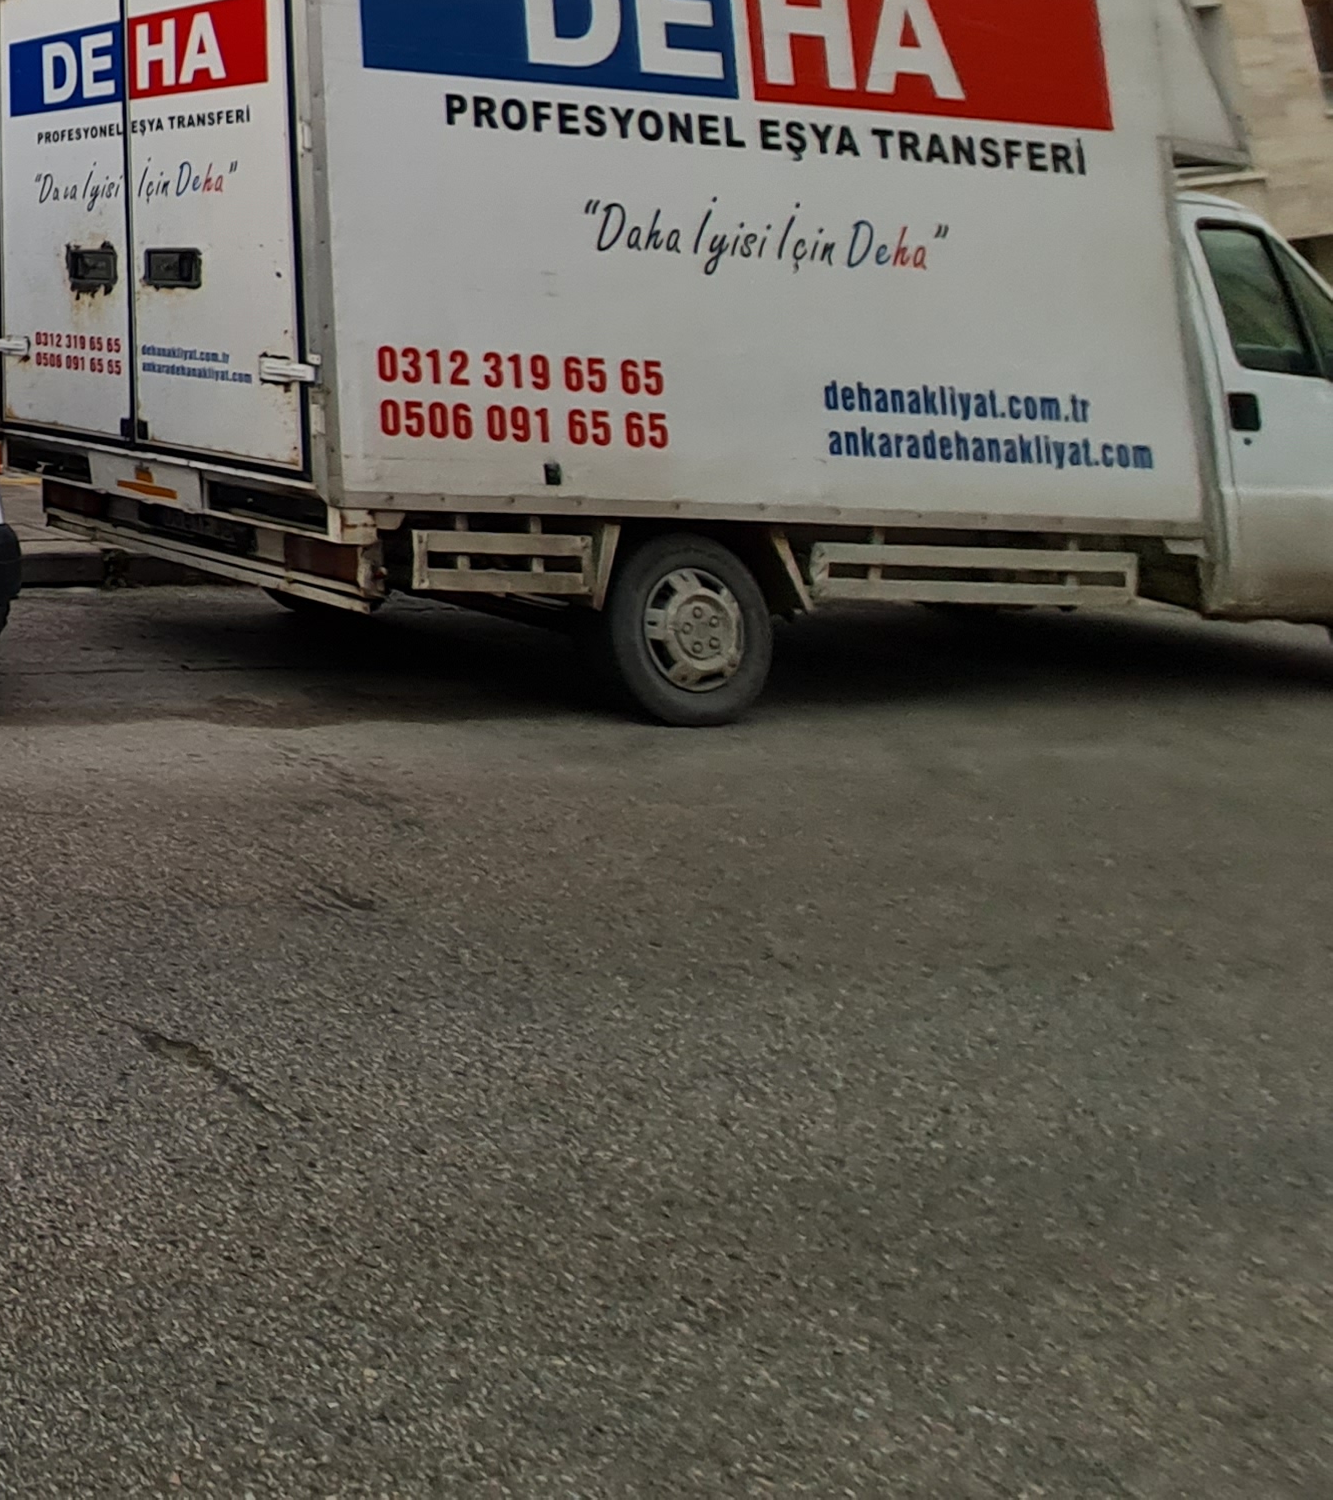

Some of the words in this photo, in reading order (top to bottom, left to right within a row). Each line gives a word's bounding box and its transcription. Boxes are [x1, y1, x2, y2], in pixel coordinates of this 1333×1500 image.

[37, 122, 124, 145] PROFESYONEL
[131, 117, 164, 136] EŞYA
[168, 104, 251, 130] TRANSFERİ
[444, 91, 746, 149] PROFESYONEL
[759, 117, 861, 163] EŞYA
[871, 126, 1088, 176] TRANSFERİ
[82, 161, 124, 212] İyisi
[137, 156, 172, 204] İçin
[693, 196, 772, 276] İyisi
[776, 202, 836, 275] İçin
[35, 331, 63, 348] 0312
[65, 334, 86, 350] 319
[89, 336, 103, 352] 65
[106, 337, 121, 354] 65
[35, 351, 63, 369] 0506
[65, 354, 86, 372] 091
[89, 357, 104, 374] 65
[107, 359, 122, 376] 65
[378, 345, 471, 386] 0312
[483, 351, 551, 391] 319
[563, 355, 608, 393] 65
[620, 359, 664, 396] 65
[380, 398, 474, 441] 0506
[486, 404, 551, 444] 091
[567, 408, 612, 447] 65
[624, 411, 669, 449] 65
[824, 379, 1092, 424] dehanakliyat.com.tr
[828, 426, 1156, 471] ankaradehanakliyat.com
